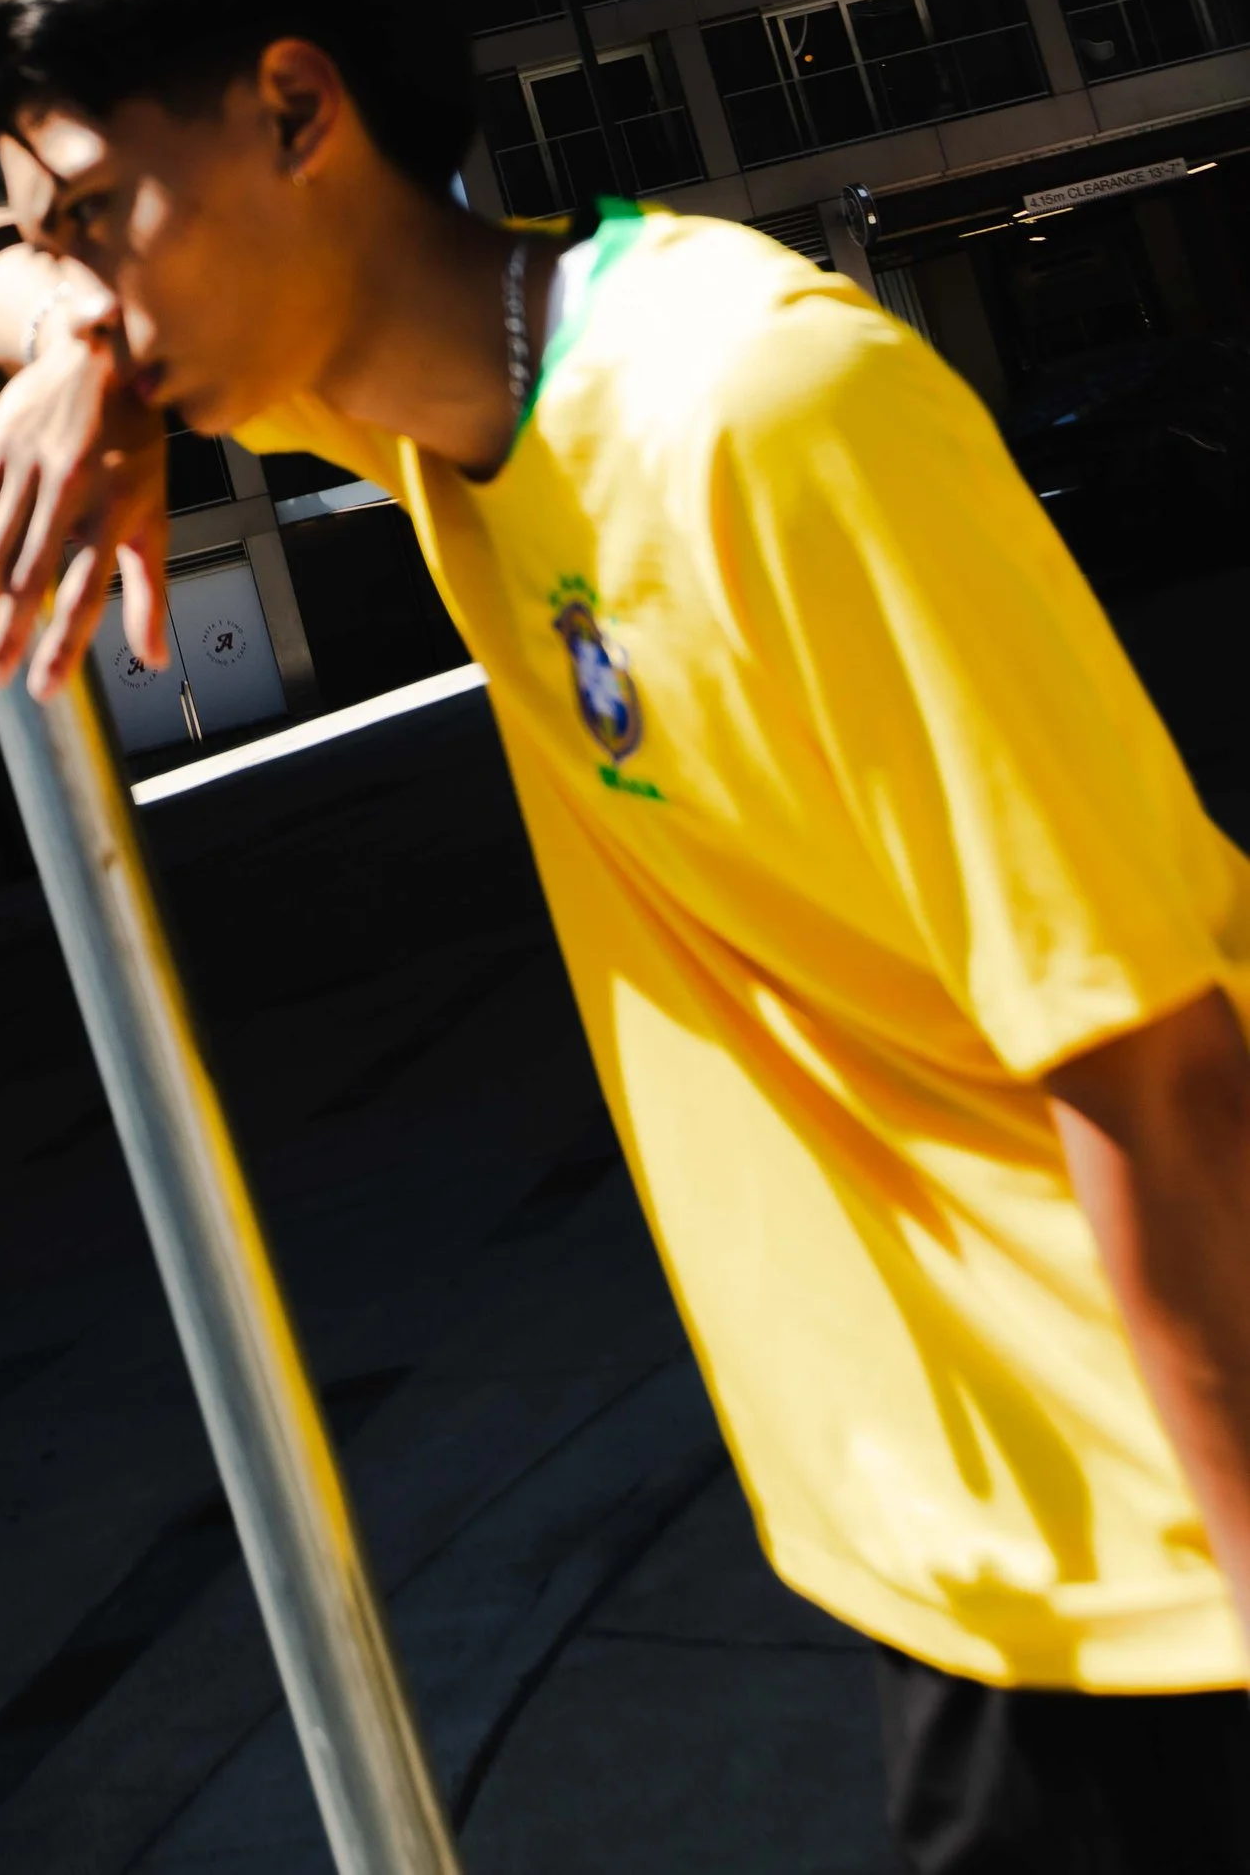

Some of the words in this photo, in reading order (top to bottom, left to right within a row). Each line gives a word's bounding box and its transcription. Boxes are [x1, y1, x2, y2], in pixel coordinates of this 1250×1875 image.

[1030, 193, 1066, 208] 4.15m
[1067, 170, 1146, 200] CLEARANCE
[215, 632, 233, 653] A
